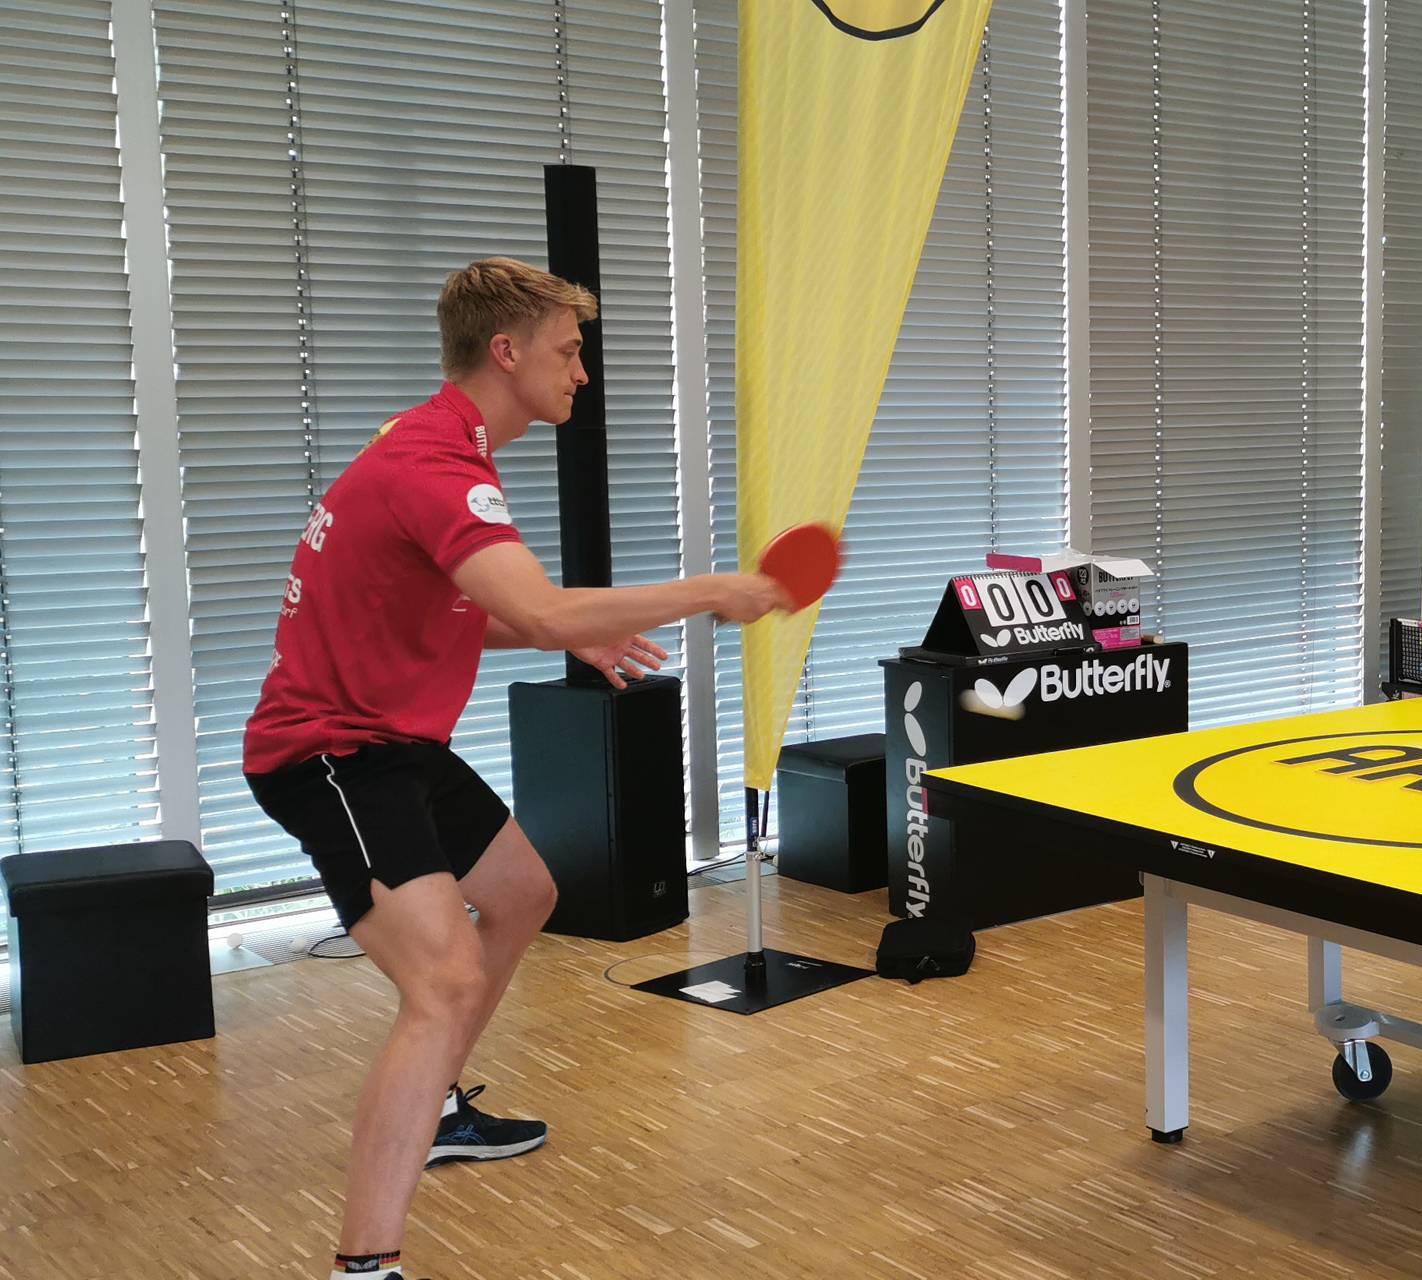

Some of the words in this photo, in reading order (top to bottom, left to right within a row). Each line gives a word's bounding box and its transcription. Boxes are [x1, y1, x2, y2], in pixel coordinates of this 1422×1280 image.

[960, 584, 977, 608] 0
[987, 583, 1016, 622] 0
[1025, 579, 1054, 617] 0
[1056, 577, 1071, 599] 0
[1013, 621, 1084, 645] Butterfly
[1041, 654, 1170, 701] Butterfly
[905, 758, 931, 919] Butterfly
